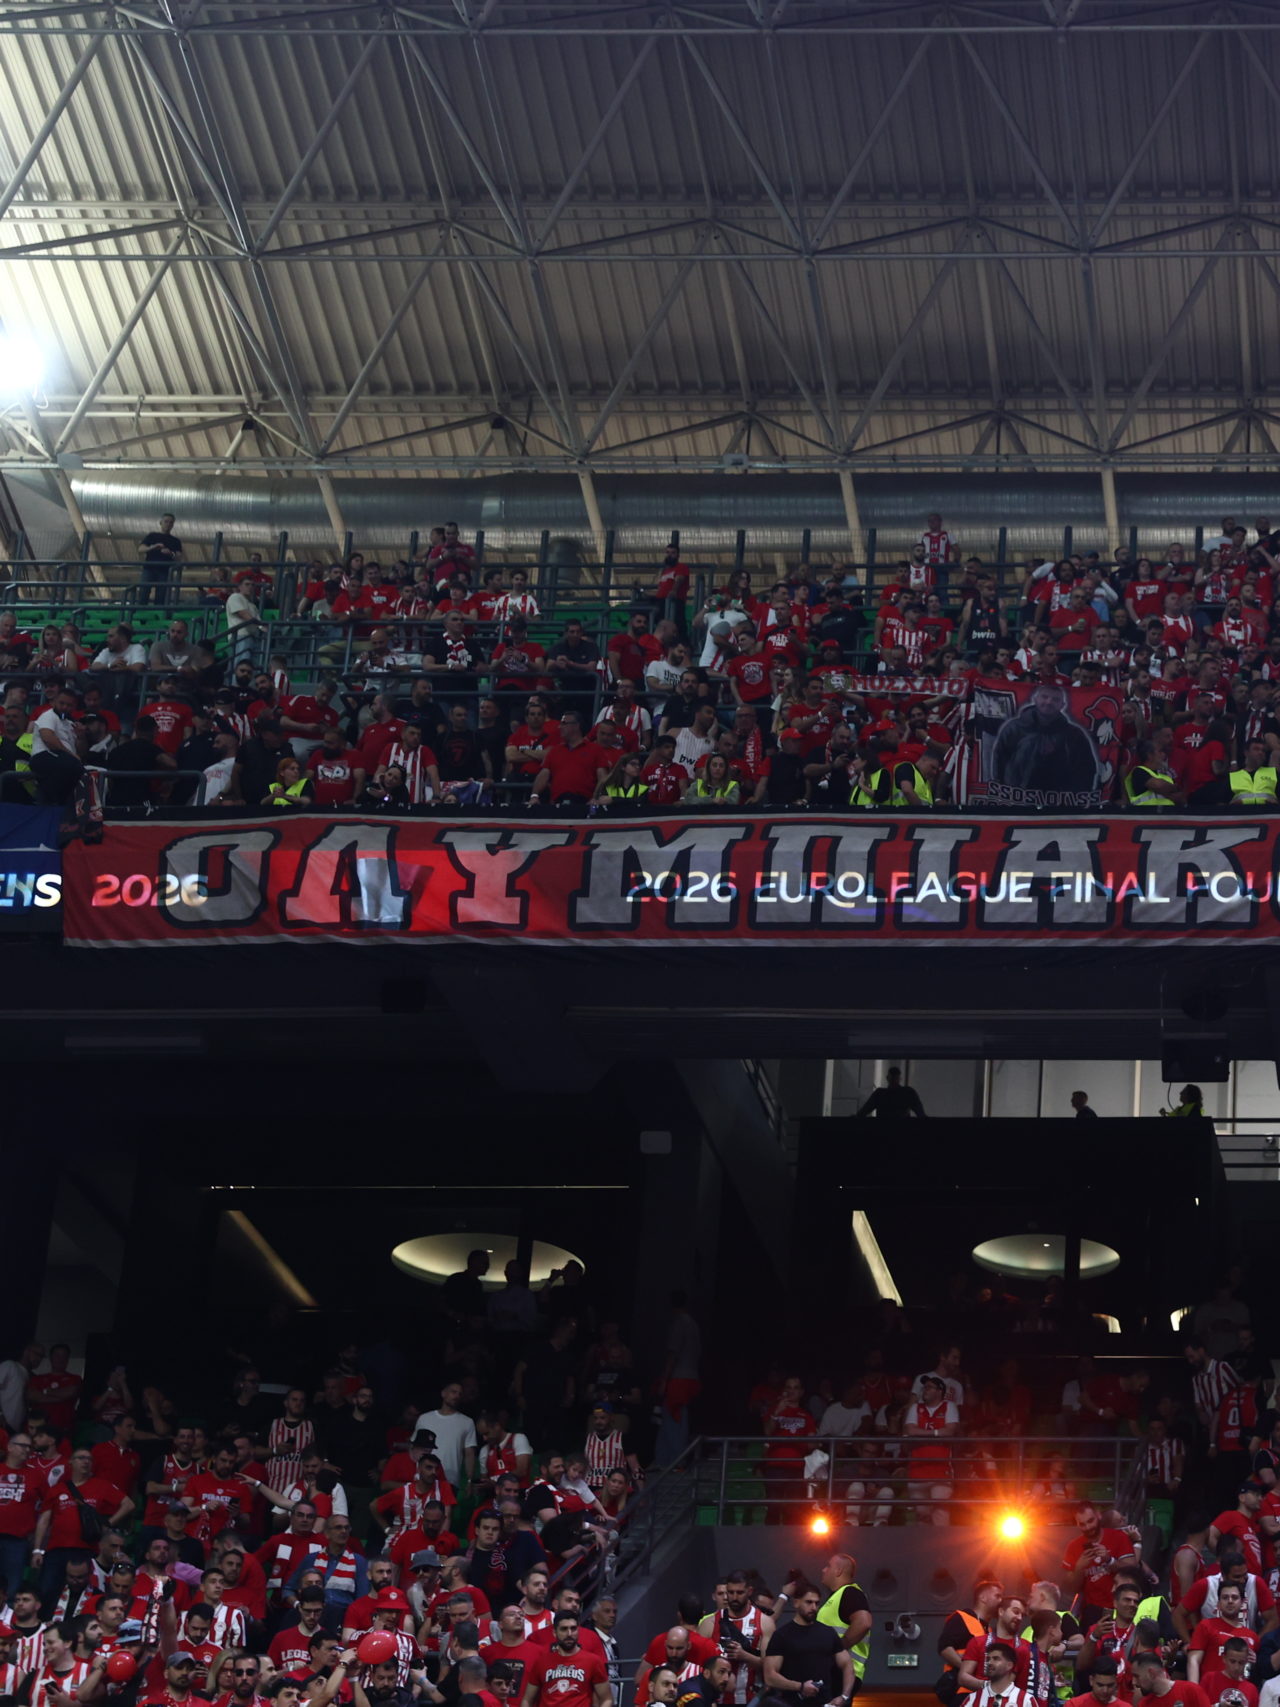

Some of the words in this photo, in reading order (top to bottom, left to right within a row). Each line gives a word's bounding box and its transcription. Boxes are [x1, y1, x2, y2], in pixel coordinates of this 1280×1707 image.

[971, 629, 996, 640] bwin
[679, 753, 696, 766] bw
[91, 873, 209, 907] 2026
[626, 870, 738, 903] 2026
[754, 870, 1034, 906] EUROLEAGUE
[1049, 870, 1170, 903] FINAL
[280, 1649, 312, 1662] LEGE
[545, 1668, 585, 1683] PIRAEUS
